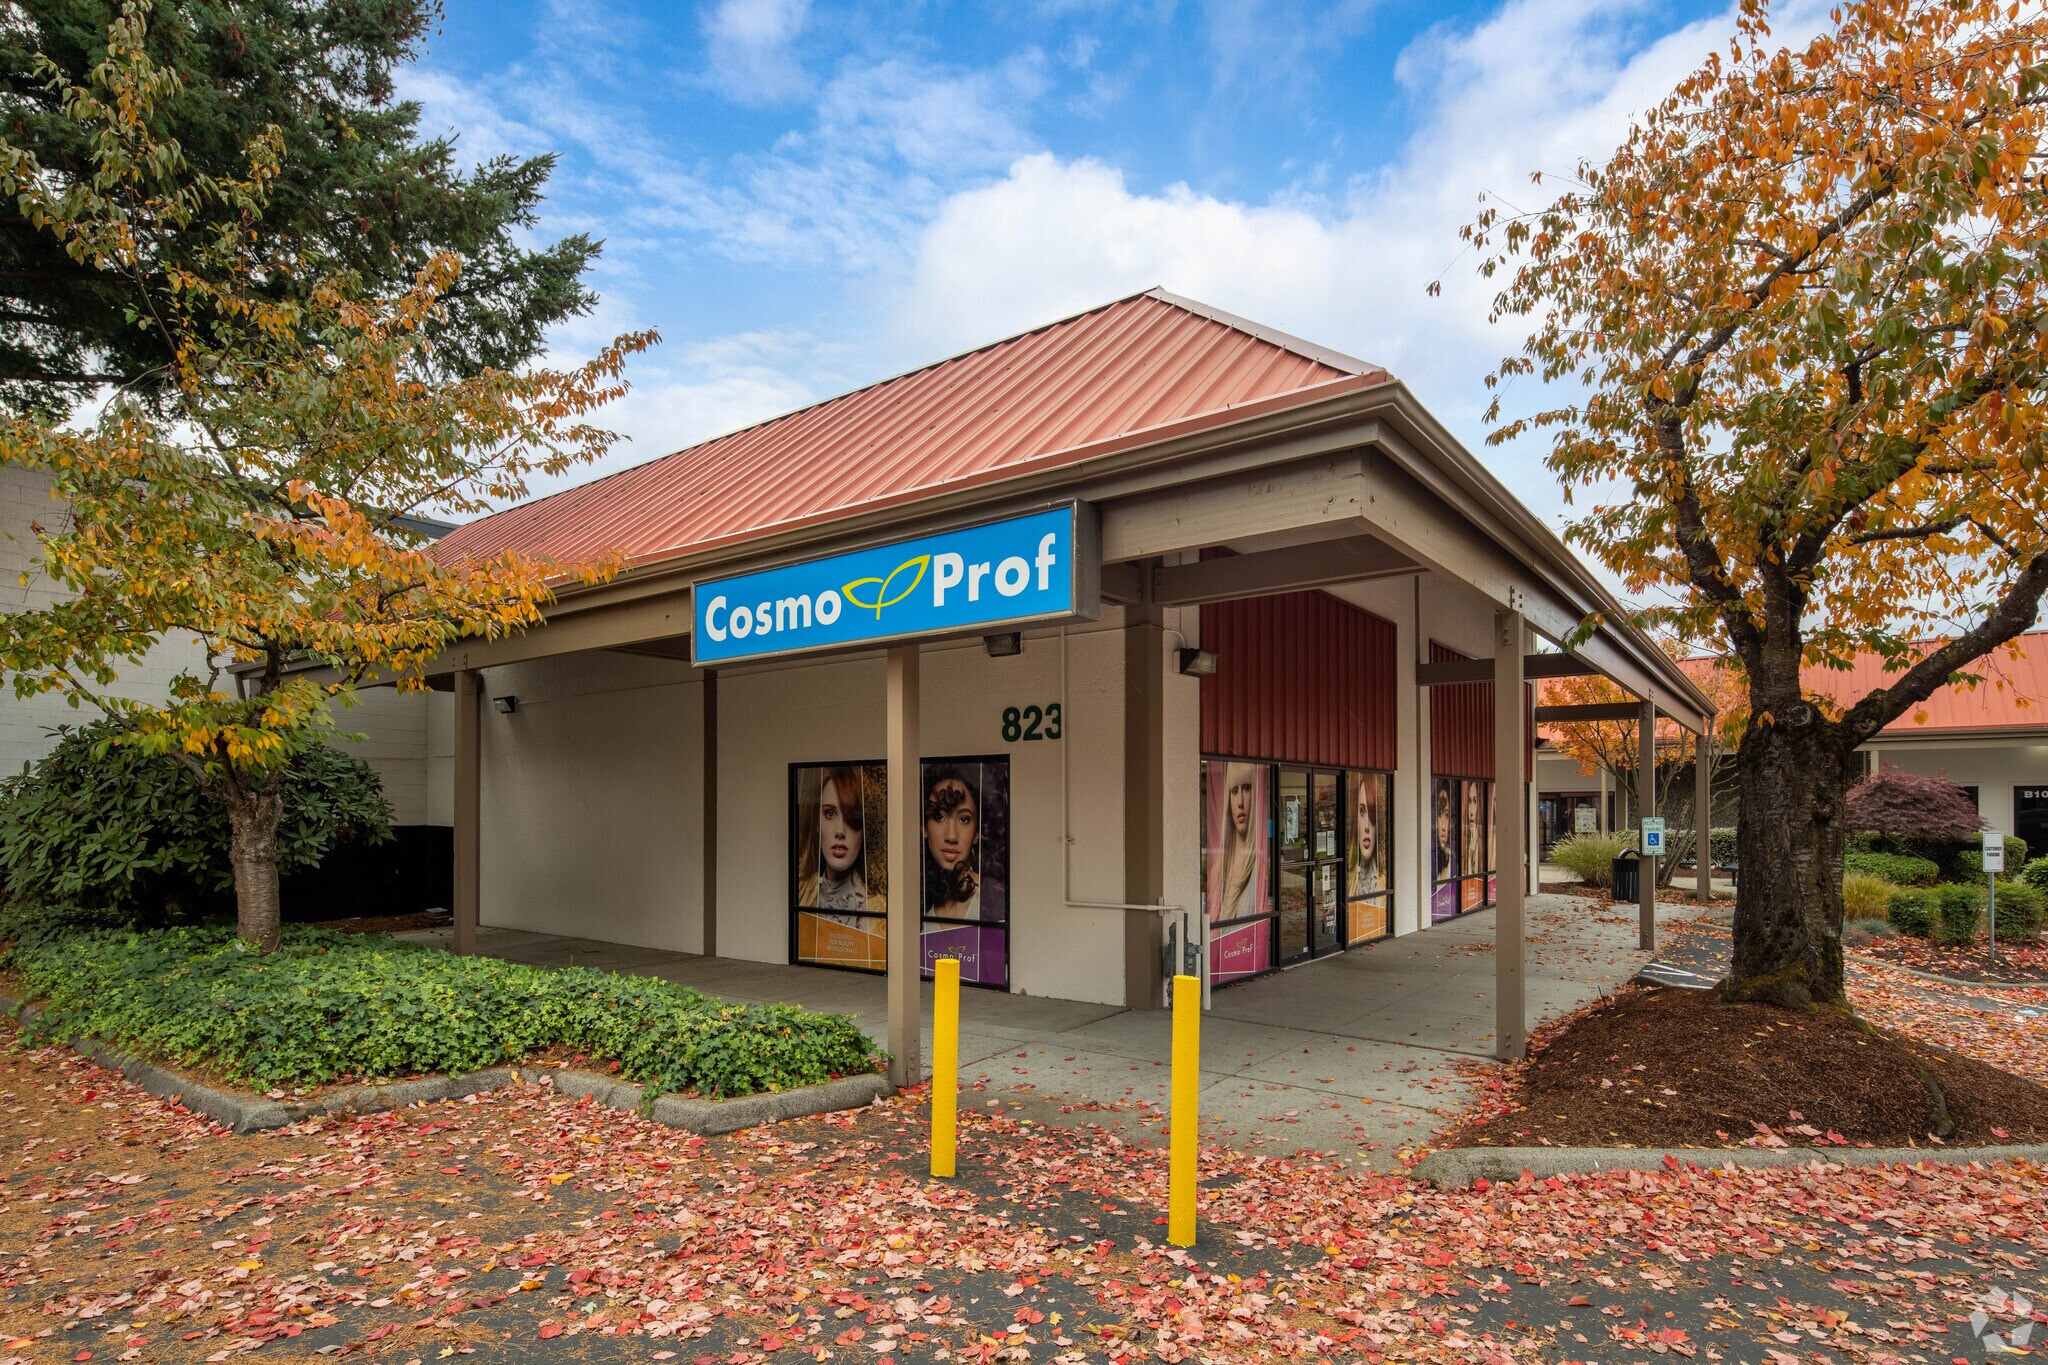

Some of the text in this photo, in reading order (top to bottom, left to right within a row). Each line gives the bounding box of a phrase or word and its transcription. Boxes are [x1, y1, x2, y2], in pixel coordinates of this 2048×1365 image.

[705, 532, 1056, 642] Cosmo Prof
[1001, 703, 1062, 742] 823
[928, 949, 976, 963] Cosmo Prof
[1223, 949, 1241, 959] Cosmo
